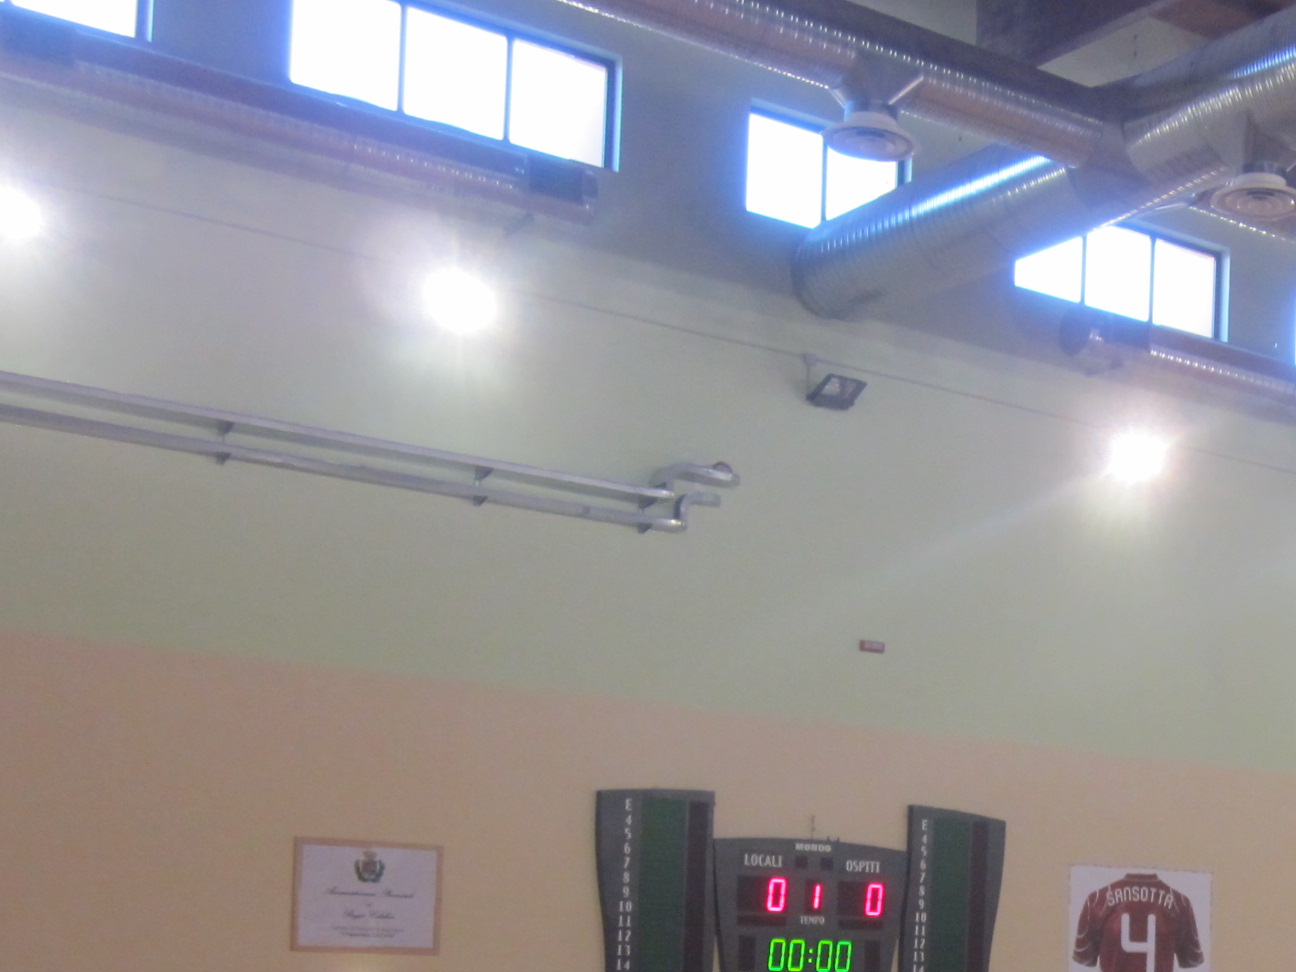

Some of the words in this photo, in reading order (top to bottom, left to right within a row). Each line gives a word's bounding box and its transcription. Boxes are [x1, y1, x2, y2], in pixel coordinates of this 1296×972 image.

[625, 798, 632, 811] E
[625, 815, 632, 825] 4
[921, 820, 928, 831] E
[624, 828, 631, 840] 5
[921, 834, 927, 844] 4
[624, 842, 631, 854] 6
[795, 843, 832, 852] MONDO
[921, 846, 927, 857] 5
[623, 857, 630, 869] 7
[744, 853, 783, 867] LOCALI
[920, 859, 926, 869] 6
[846, 860, 880, 873] OSPITI
[623, 871, 630, 883] 8
[920, 872, 926, 883] 7
[622, 885, 629, 897] 9
[766, 877, 787, 912] 0
[919, 885, 925, 896] 8
[813, 884, 822, 909] 1
[865, 882, 884, 916] 0
[1106, 886, 1174, 910] SANSOTTA
[619, 901, 632, 912] 10
[918, 898, 925, 909] 9
[618, 916, 631, 927] 11
[800, 916, 825, 925] TEMPO
[915, 912, 926, 923] 10
[617, 930, 631, 941] 12
[914, 925, 926, 936] 11
[914, 938, 925, 949] 12
[617, 944, 631, 956] 13
[768, 938, 852, 972] 00:00
[913, 951, 924, 962] 13
[616, 959, 630, 970] 14
